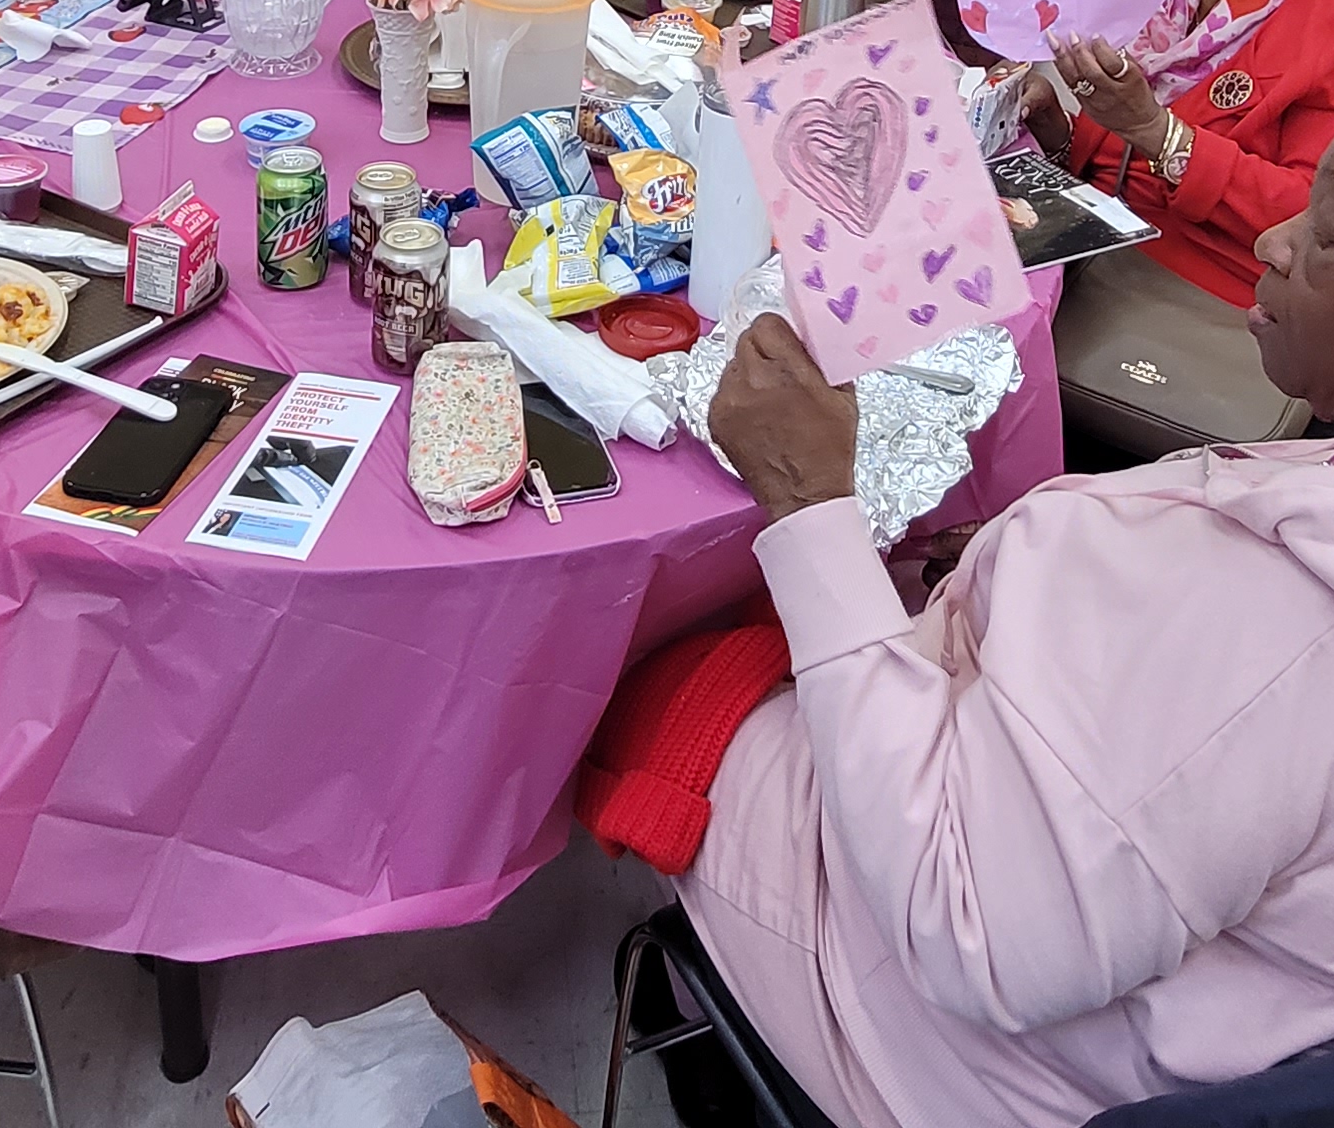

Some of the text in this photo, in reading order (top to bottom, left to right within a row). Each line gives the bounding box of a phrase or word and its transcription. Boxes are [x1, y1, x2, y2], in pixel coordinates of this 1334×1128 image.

[391, 319, 415, 334] BEER
[292, 391, 346, 403] PROTECT
[284, 405, 318, 415] FROM
[289, 398, 349, 412] YOURSELF
[275, 419, 313, 431] THEFT
[279, 412, 334, 426] IDENTITY
